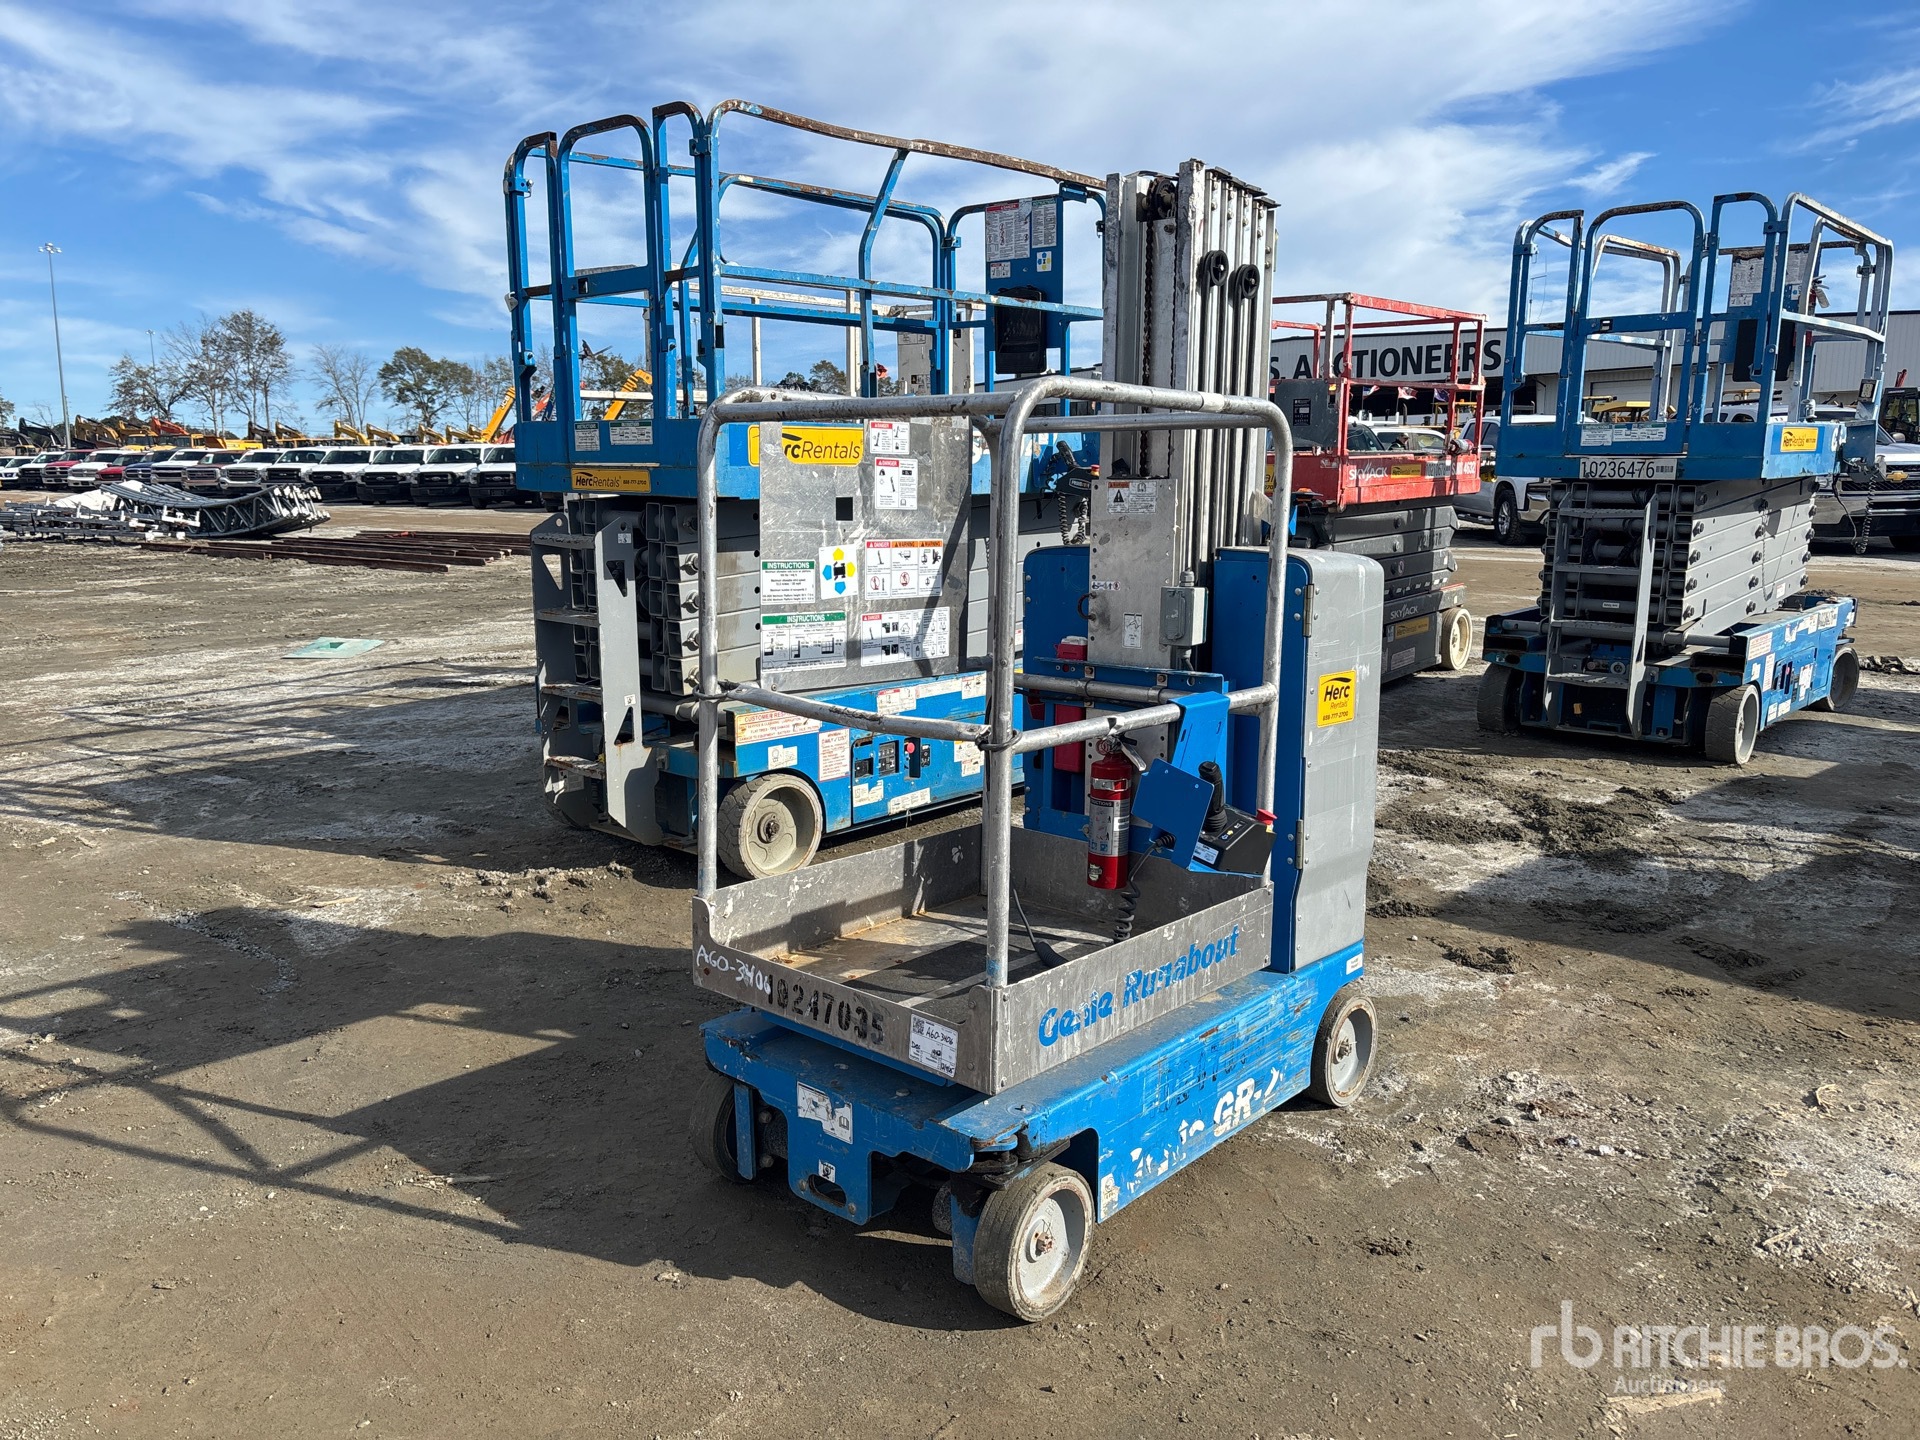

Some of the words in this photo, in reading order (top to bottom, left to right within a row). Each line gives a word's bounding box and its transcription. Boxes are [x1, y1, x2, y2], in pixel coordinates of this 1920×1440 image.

[1292, 339, 1502, 379] ACTIONEERS
[500, 395, 511, 411] JCB
[1349, 460, 1388, 481] SKYJACK
[1581, 461, 1655, 478] 10236476
[1390, 604, 1419, 620] SKYJACK
[1324, 685, 1350, 702] Herc
[696, 945, 772, 995] A60-3406
[1038, 991, 1115, 1047] Genie
[1123, 924, 1240, 1008] Runabout
[767, 974, 884, 1045] 10247035
